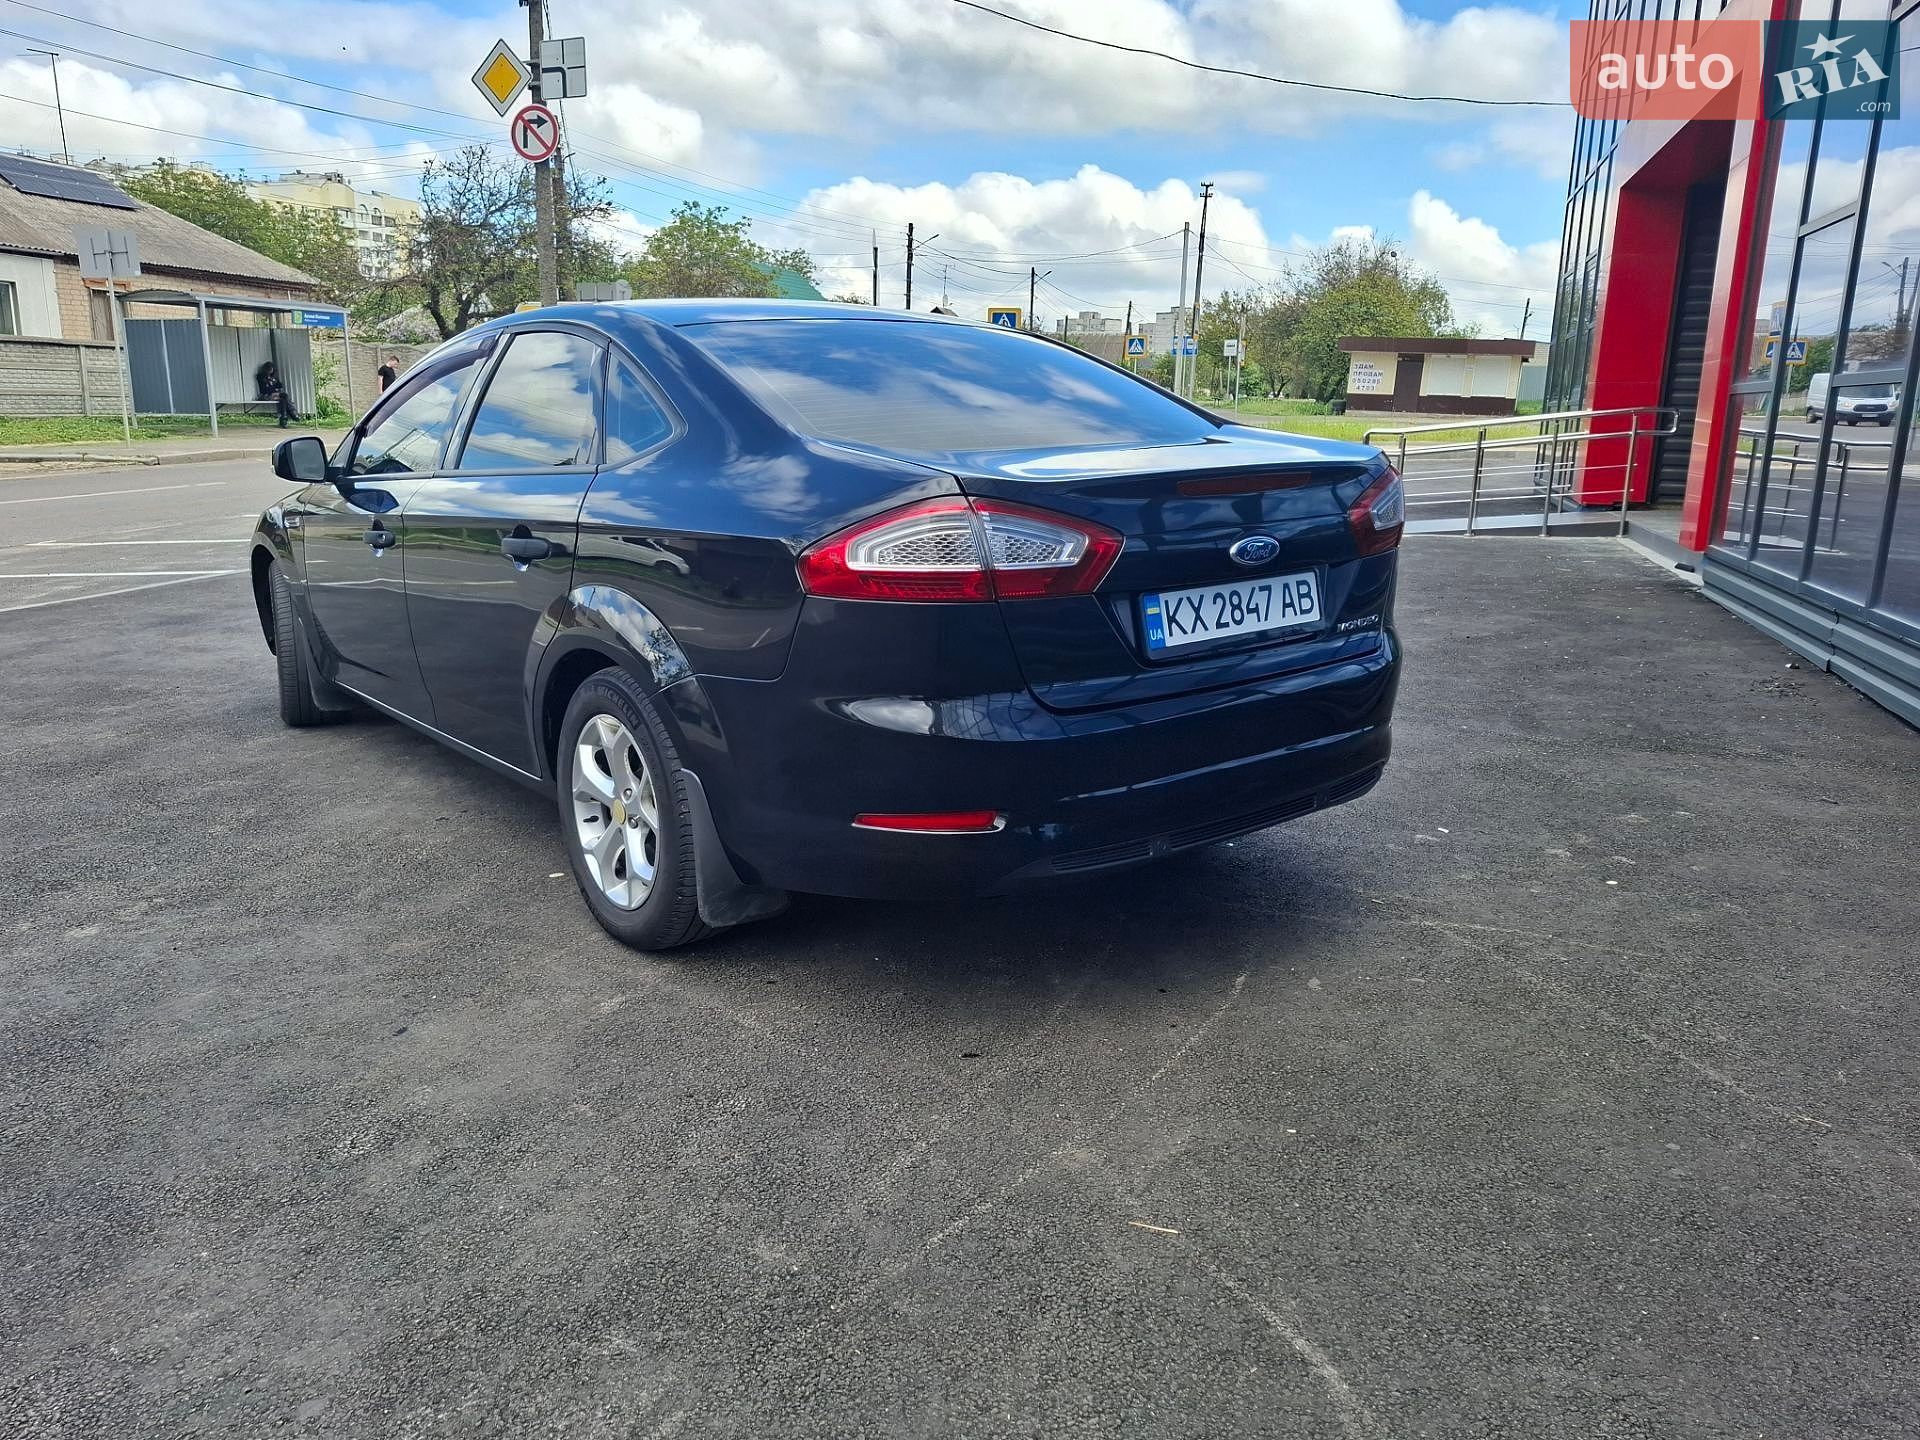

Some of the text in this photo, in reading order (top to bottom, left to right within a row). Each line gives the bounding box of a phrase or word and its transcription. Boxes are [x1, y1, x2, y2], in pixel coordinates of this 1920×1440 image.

[1244, 542, 1272, 561] Ford
[1164, 579, 1314, 637] KX 2847 AB
[1337, 614, 1379, 632] MONDEO
[1151, 630, 1164, 641] UA
